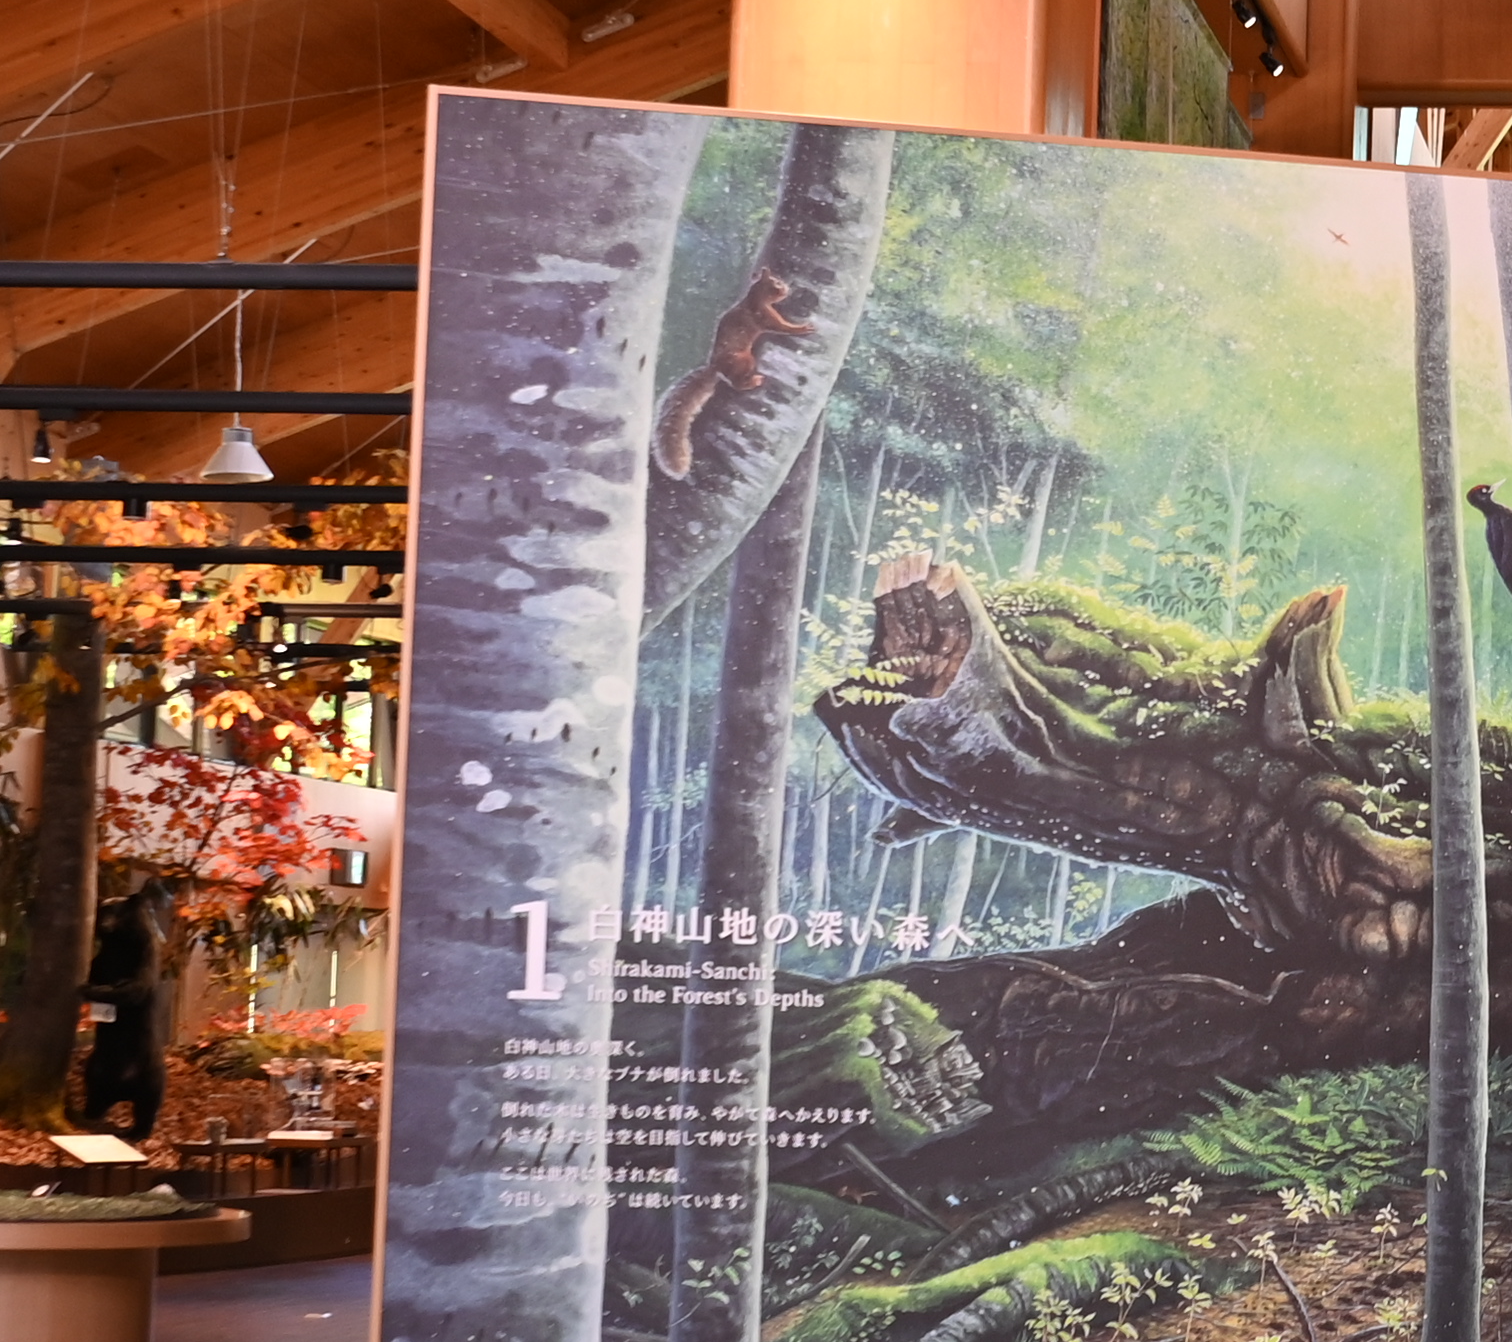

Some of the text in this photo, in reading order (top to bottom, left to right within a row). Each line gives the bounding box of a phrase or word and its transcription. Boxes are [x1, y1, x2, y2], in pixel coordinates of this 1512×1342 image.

[587, 903, 975, 953] 白神山地の深い森へ
[506, 899, 563, 1002] 1
[587, 958, 776, 982] Shirakami-Sanchi:
[588, 984, 825, 1010] Into the Forest's Depths
